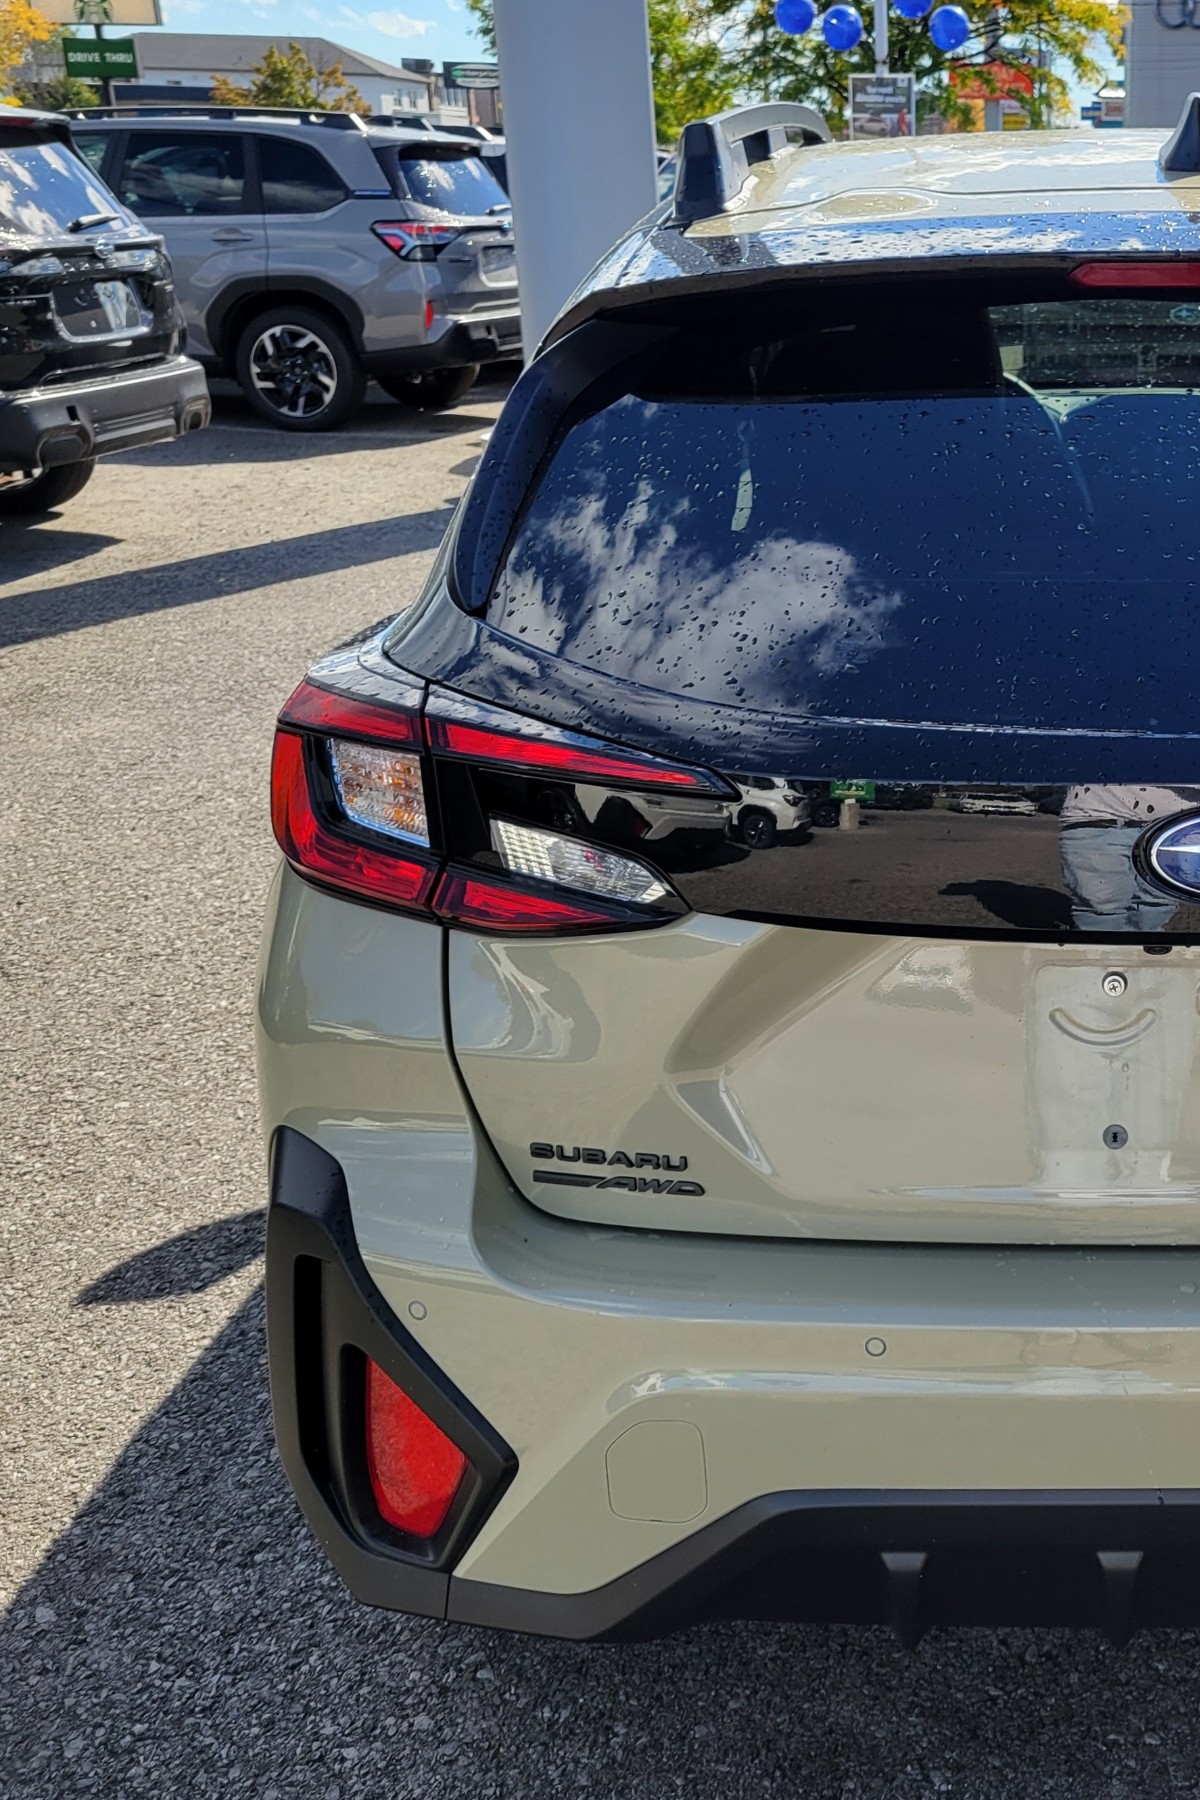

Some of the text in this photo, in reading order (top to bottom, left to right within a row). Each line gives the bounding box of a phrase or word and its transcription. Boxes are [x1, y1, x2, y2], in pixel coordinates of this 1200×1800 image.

[67, 52, 133, 64] DRIVE THRU
[530, 1142, 689, 1172] SUBARU
[597, 1175, 706, 1197] AWD
